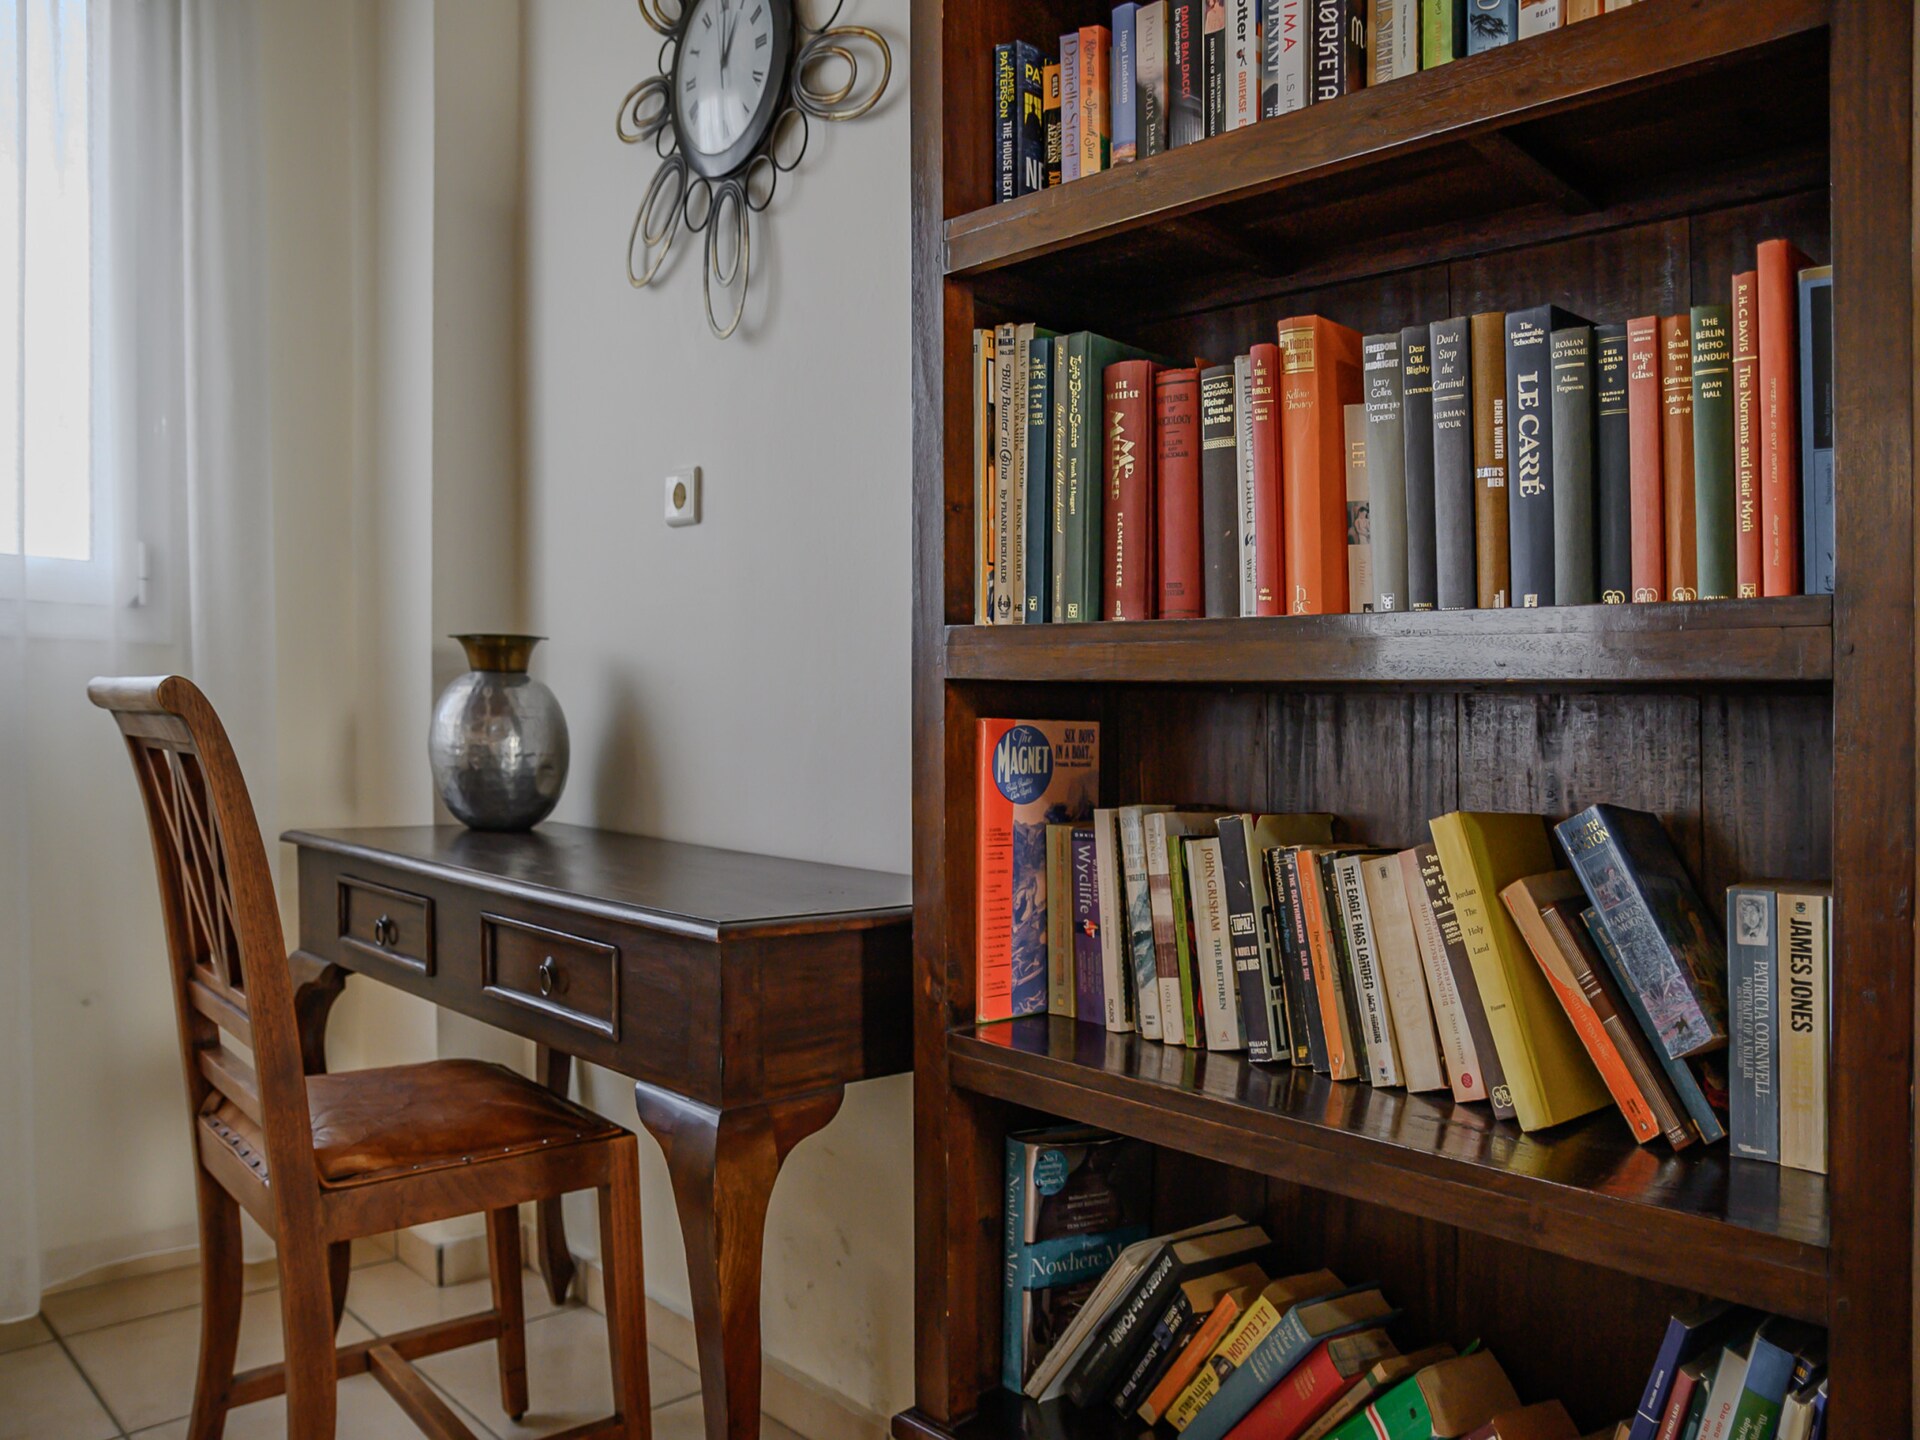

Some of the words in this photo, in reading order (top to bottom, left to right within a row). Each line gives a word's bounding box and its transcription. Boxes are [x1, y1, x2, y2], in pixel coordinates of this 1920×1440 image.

[1536, 6, 1556, 18] DEATH
[1180, 5, 1189, 39] DAVID
[1120, 30, 1129, 52] Inga
[1085, 39, 1096, 78] Retreat
[1063, 39, 1078, 111] Danielle
[1121, 55, 1130, 104] Lindström
[1181, 41, 1190, 99] BALDACCI
[999, 51, 1009, 119] PATTERSON
[1005, 65, 1015, 103] JAMES
[1238, 71, 1247, 114] GRIEKSE
[1083, 97, 1097, 137] Spanish
[1001, 120, 1012, 140] THE
[1064, 112, 1079, 158] Steel
[1002, 141, 1012, 172] HOUSE
[1084, 137, 1096, 160] Sun
[1002, 173, 1012, 197] NEXT
[1519, 321, 1533, 330] The
[1701, 318, 1718, 327] THE
[1436, 333, 1459, 345] Don't
[1510, 327, 1545, 340] Honourable
[1513, 336, 1543, 347] Schoolboy
[1674, 329, 1681, 337] A
[1695, 328, 1725, 339] BERLIN
[1739, 320, 1749, 352] DAVIS
[1365, 342, 1397, 354] FREEDOM
[1408, 344, 1426, 355] Dear
[1552, 349, 1563, 359] GO
[1565, 347, 1588, 357] HOME
[1555, 338, 1584, 350] ROMAN
[1667, 340, 1689, 349] Small
[1697, 340, 1726, 351] MEMO-
[1410, 354, 1423, 364] Old
[1438, 349, 1457, 361] Stop
[1599, 356, 1623, 364] HUMAN
[1632, 352, 1653, 364] Edge
[1668, 353, 1689, 361] Town
[1693, 351, 1730, 364] RANDUM
[1070, 355, 1082, 380] Life
[1254, 368, 1268, 377] TIME
[1365, 359, 1400, 371] MIDNIGHT
[1406, 364, 1431, 376] Blighty
[1441, 363, 1454, 375] the
[1637, 362, 1646, 370] of
[1000, 363, 1011, 394] Billy
[1372, 378, 1389, 388] Larry
[1433, 376, 1465, 391] Carnival
[1632, 370, 1654, 380] Glass
[1740, 365, 1752, 388] The
[1203, 381, 1228, 391] NICHOLAS
[1252, 387, 1271, 396] TURKEY
[1370, 388, 1393, 398] Collins
[1517, 370, 1539, 410] LE
[1701, 381, 1722, 389] ADAM
[1703, 389, 1722, 399] HALL
[1070, 381, 1081, 412] Below
[1204, 398, 1226, 408] Richer
[1665, 394, 1684, 403] John
[1001, 396, 1012, 436] Bunter
[1208, 407, 1223, 415] than
[1224, 404, 1233, 413] all
[1365, 401, 1400, 413] Dominique
[1433, 409, 1466, 420] HERMAN
[1493, 399, 1503, 424] DENIS
[1204, 417, 1214, 426] his
[1214, 415, 1231, 424] tribe
[1437, 420, 1461, 429] WOUK
[1740, 391, 1752, 444] Normans
[1070, 413, 1081, 448] Stairs
[1001, 437, 1010, 448] in
[1494, 426, 1504, 460] WINTER
[1352, 442, 1366, 468] LEE
[1517, 414, 1546, 498] CARRÉ
[1741, 447, 1752, 467] and
[1476, 466, 1504, 479] DEATH'S
[1487, 478, 1504, 488] MEN
[1741, 470, 1753, 497] their
[1000, 501, 1008, 535] FRANK
[1741, 500, 1754, 533] Myth
[1000, 536, 1008, 584] RICHARDS
[1012, 728, 1032, 746] The
[1064, 729, 1075, 743] SIX
[1078, 729, 1095, 744] BOYS
[997, 733, 1050, 783] MAGNET
[1055, 745, 1064, 759] IN
[1064, 745, 1070, 759] A
[1148, 828, 1156, 865] FRENCH
[1201, 848, 1214, 880] JOHN
[1425, 854, 1439, 863] The
[1077, 845, 1092, 914] Wycliffe
[1273, 848, 1286, 903] RINGWORLD
[1342, 865, 1355, 887] THE
[1422, 865, 1439, 876] Smile
[1425, 878, 1436, 887] the
[1438, 885, 1446, 895] of
[1432, 899, 1443, 908] the
[1455, 888, 1477, 900] Jordan
[1206, 880, 1221, 931] GRISHAM
[1345, 887, 1362, 921] EAGLE
[1464, 908, 1477, 917] The
[1233, 917, 1251, 931] TOPAZ
[1291, 887, 1305, 944] DEATHMAKERS
[1617, 916, 1644, 933] MOON
[1352, 923, 1366, 946] HAS
[1468, 926, 1484, 937] Holy
[1213, 938, 1222, 957] THE
[1237, 946, 1251, 956] NOVEL
[1472, 944, 1490, 955] Land
[1790, 917, 1813, 976] JAMES
[1315, 944, 1325, 981] Comedians
[1356, 947, 1374, 990] LANDED
[1215, 958, 1226, 1010] BRETHREN
[1754, 960, 1769, 1021] PATRICIA
[1367, 993, 1376, 1013] JACK
[1742, 976, 1753, 1021] PORTRAIT
[1791, 977, 1813, 1033] JONES
[1369, 1014, 1382, 1044] HIGGINS
[1743, 1023, 1753, 1035] OF
[1248, 1040, 1268, 1048] WILLIAM
[1743, 1036, 1753, 1044] A
[1743, 1045, 1753, 1079] KILLER
[1755, 1022, 1770, 1098] CORNWELL
[1008, 1174, 1020, 1242] Nowhere
[1007, 1252, 1018, 1288] Man
[1031, 1252, 1100, 1278] Nowhere
[1128, 1296, 1147, 1315] the
[1161, 1305, 1180, 1325] SMITH
[1252, 1306, 1273, 1327] J.T.
[1106, 1309, 1140, 1348] FORUM
[1225, 1321, 1262, 1361] ELLISON
[1190, 1373, 1214, 1398] PRETTY
[1177, 1395, 1197, 1416] GIRLS
